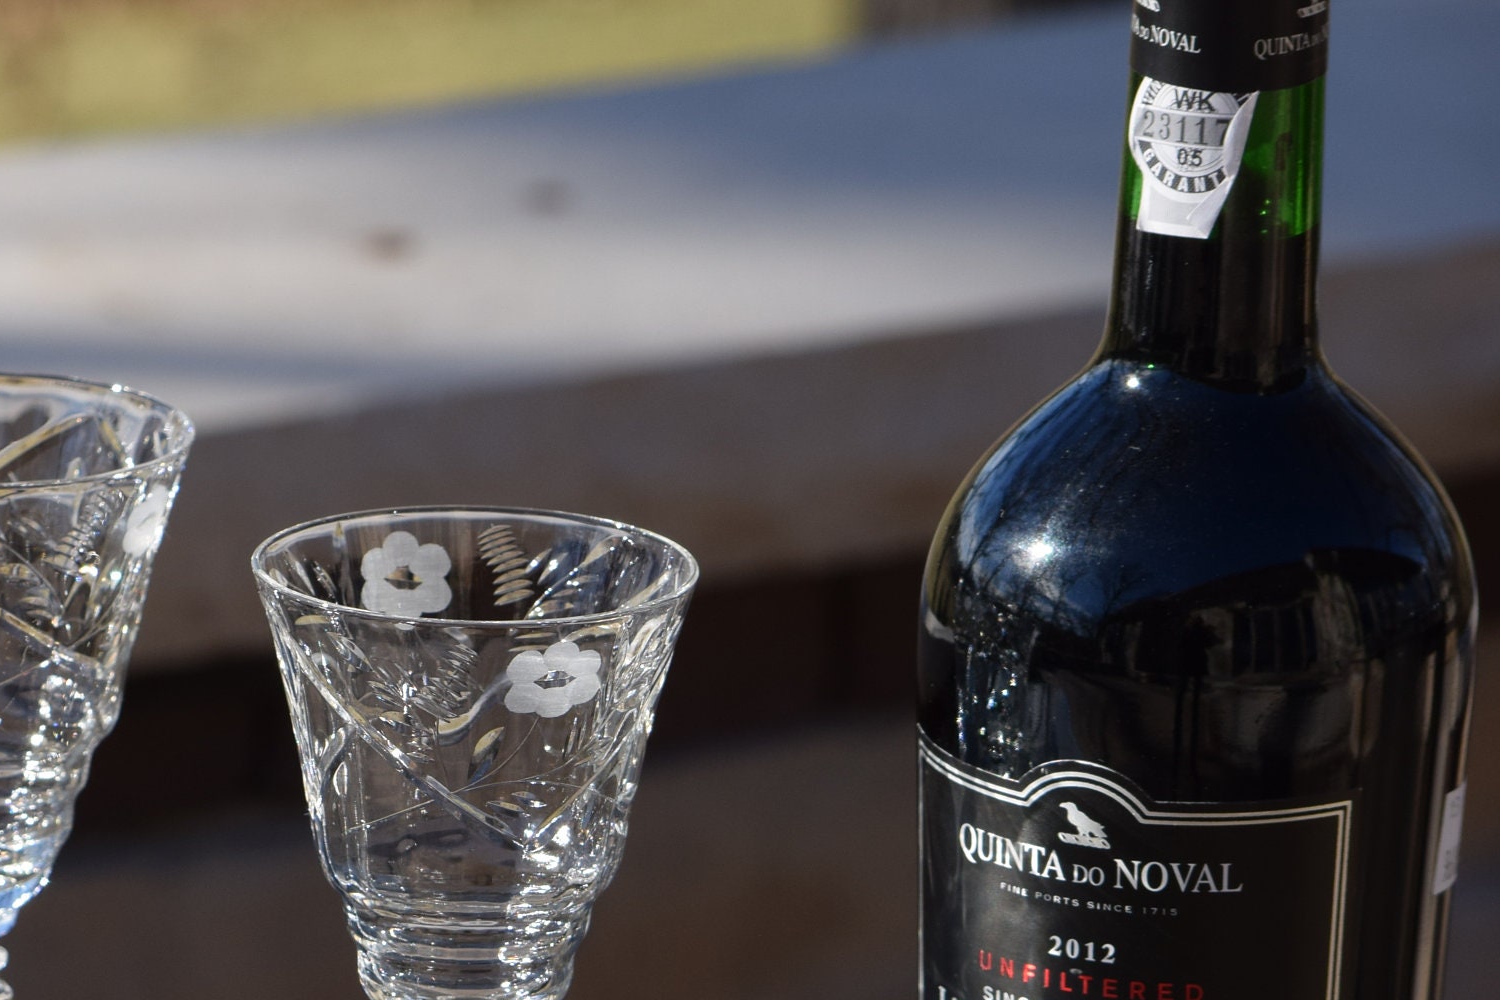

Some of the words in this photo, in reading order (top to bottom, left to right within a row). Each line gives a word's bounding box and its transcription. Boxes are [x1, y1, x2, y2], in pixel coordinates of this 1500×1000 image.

[1149, 24, 1202, 54] NOVAL
[1253, 32, 1310, 61] QUINTA
[959, 822, 1067, 882] QUINTA
[1071, 863, 1105, 887] DO
[1113, 857, 1244, 893] NOVAL
[999, 881, 1029, 898] FINE
[1034, 891, 1080, 907] PORTS
[1086, 900, 1132, 914] SINCE
[1141, 906, 1179, 917] 1715
[1047, 934, 1116, 964] 2012
